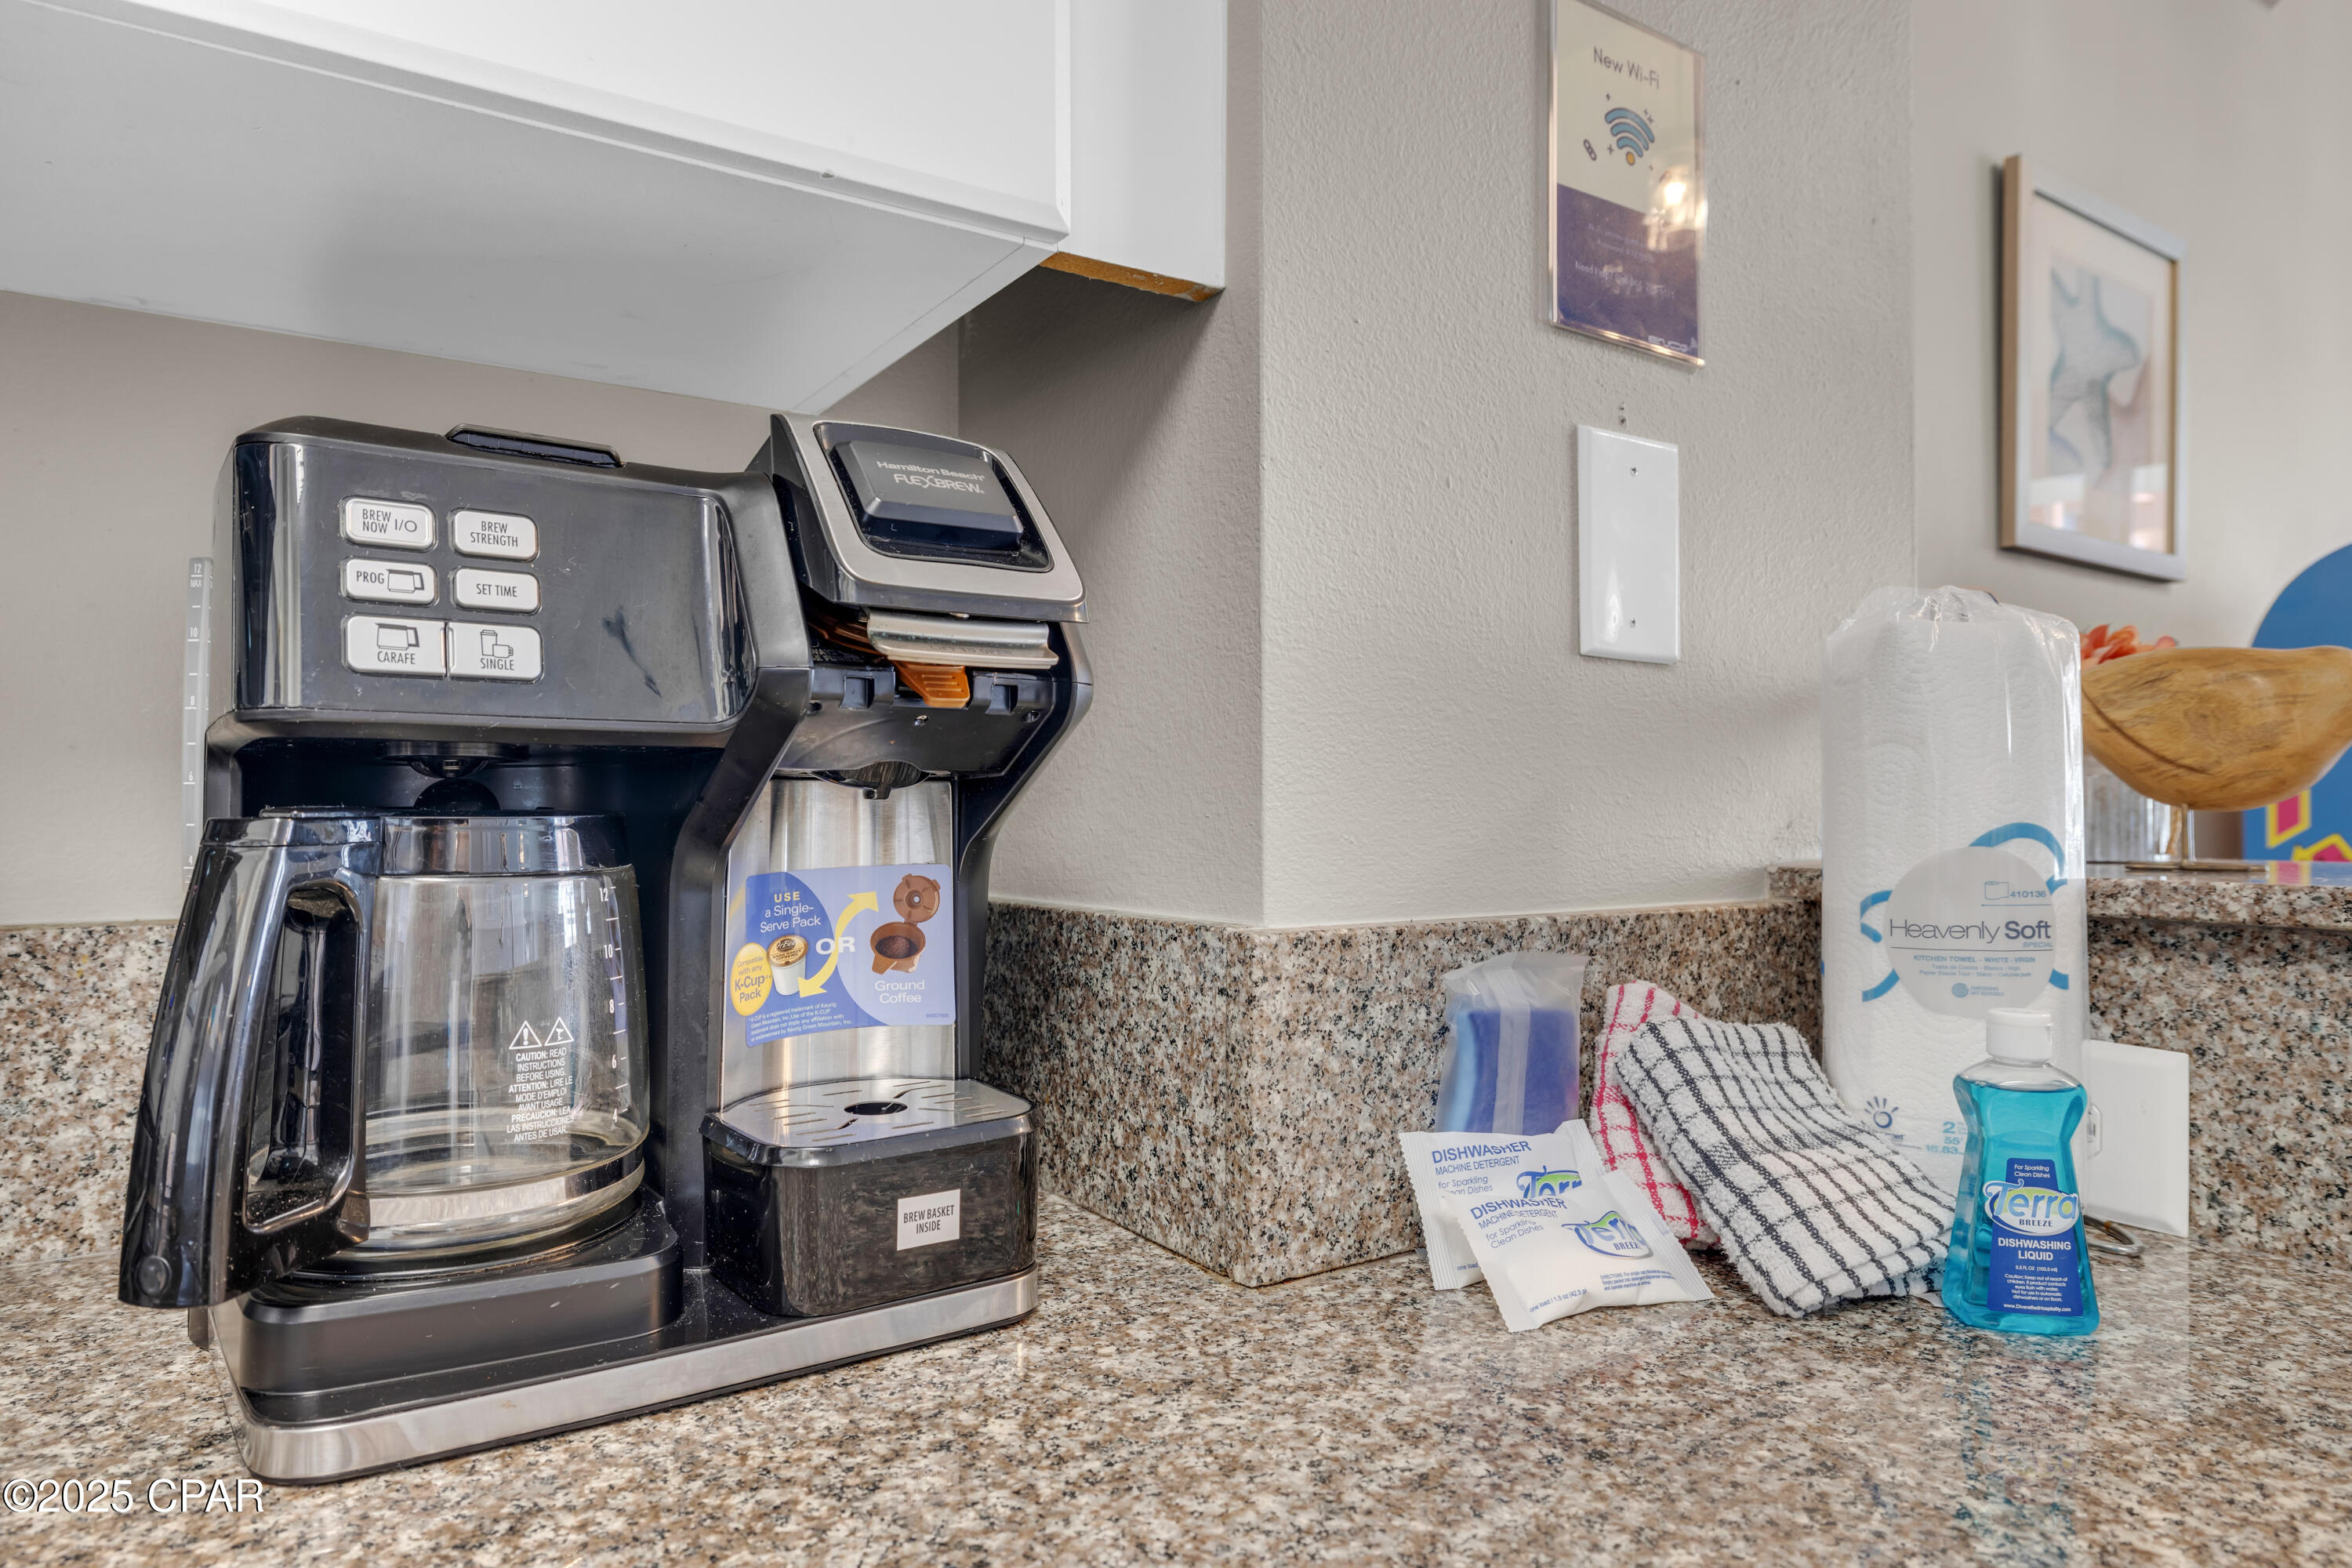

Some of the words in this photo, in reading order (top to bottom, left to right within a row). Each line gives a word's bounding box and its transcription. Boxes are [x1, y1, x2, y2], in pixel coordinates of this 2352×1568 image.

[1593, 45, 1623, 75] New
[1627, 58, 1660, 89] Wi-Fi
[877, 461, 940, 474] Hamilton
[362, 509, 391, 522] BREW
[362, 521, 388, 534] NOW
[481, 521, 508, 533] BREW
[470, 532, 518, 547] STRENGTH
[194, 563, 201, 573] 12
[191, 579, 201, 587] MAX
[356, 571, 385, 584] PROG
[477, 584, 492, 595] SET
[495, 585, 517, 597] TIME
[190, 627, 198, 637] 10
[377, 651, 416, 665] CARAFE
[480, 658, 514, 670] SINGLE
[190, 695, 195, 705] 8
[188, 771, 194, 781] 6
[188, 855, 193, 865] 4
[599, 887, 609, 902] 12
[774, 891, 800, 902] USE
[764, 909, 771, 918] a
[774, 903, 814, 920] Single-
[760, 920, 789, 933] Serve
[792, 916, 821, 928] Pack
[1889, 918, 2001, 944] Heavenly
[2004, 920, 2052, 940] Soft
[604, 944, 613, 959] 10
[815, 936, 855, 955] OR
[739, 967, 750, 976] with
[875, 979, 925, 992] Ground
[739, 988, 761, 1003] Pack
[880, 993, 922, 1004] Coffee
[609, 999, 615, 1013] 8
[516, 1052, 548, 1062] CAUTION:
[550, 1047, 567, 1058] READ
[612, 1054, 617, 1069] 6
[517, 1058, 565, 1072] INSTRUCTIONS
[517, 1071, 544, 1083] BEFORE
[545, 1068, 565, 1079] USING.
[509, 1080, 548, 1094] ATTENTION:
[550, 1078, 564, 1088] LIRE
[564, 1076, 573, 1085] LE
[515, 1092, 536, 1102] MODE
[537, 1087, 568, 1100] D'EMPLOI
[518, 1102, 540, 1112] AVANT
[542, 1098, 564, 1108] USAGE.
[511, 1109, 557, 1123] PRECAUCION:
[559, 1105, 572, 1116] LEA
[613, 1109, 618, 1123] 4
[506, 1123, 521, 1133] LAS
[522, 1114, 574, 1131] INSTRUCCIONES
[1943, 1121, 1955, 1134] 2
[514, 1131, 537, 1142] ANTES
[538, 1129, 549, 1138] DE
[1432, 1142, 1532, 1163] DISHWASHER
[1926, 1145, 1958, 1154] 16.83
[1436, 1162, 1472, 1175] MACHINE
[1474, 1156, 1519, 1170] DETERGENT
[1452, 1176, 1488, 1187] Sparkling
[1468, 1185, 1494, 1194] Dishes
[1984, 1179, 2078, 1220] Terra
[904, 1210, 925, 1223] BREW
[927, 1205, 954, 1219] BASKET
[1470, 1197, 1567, 1219] DISHWASHER
[1479, 1210, 1515, 1229] MACHINE
[1515, 1209, 1557, 1218] DETERGENT
[916, 1220, 941, 1234] INSIDE
[1486, 1232, 1497, 1241] for
[1490, 1234, 1517, 1248] Clean
[1518, 1225, 1544, 1236] Dishes
[1998, 1238, 2071, 1250] DISHWASHING
[2018, 1250, 2053, 1261] LIQUID
